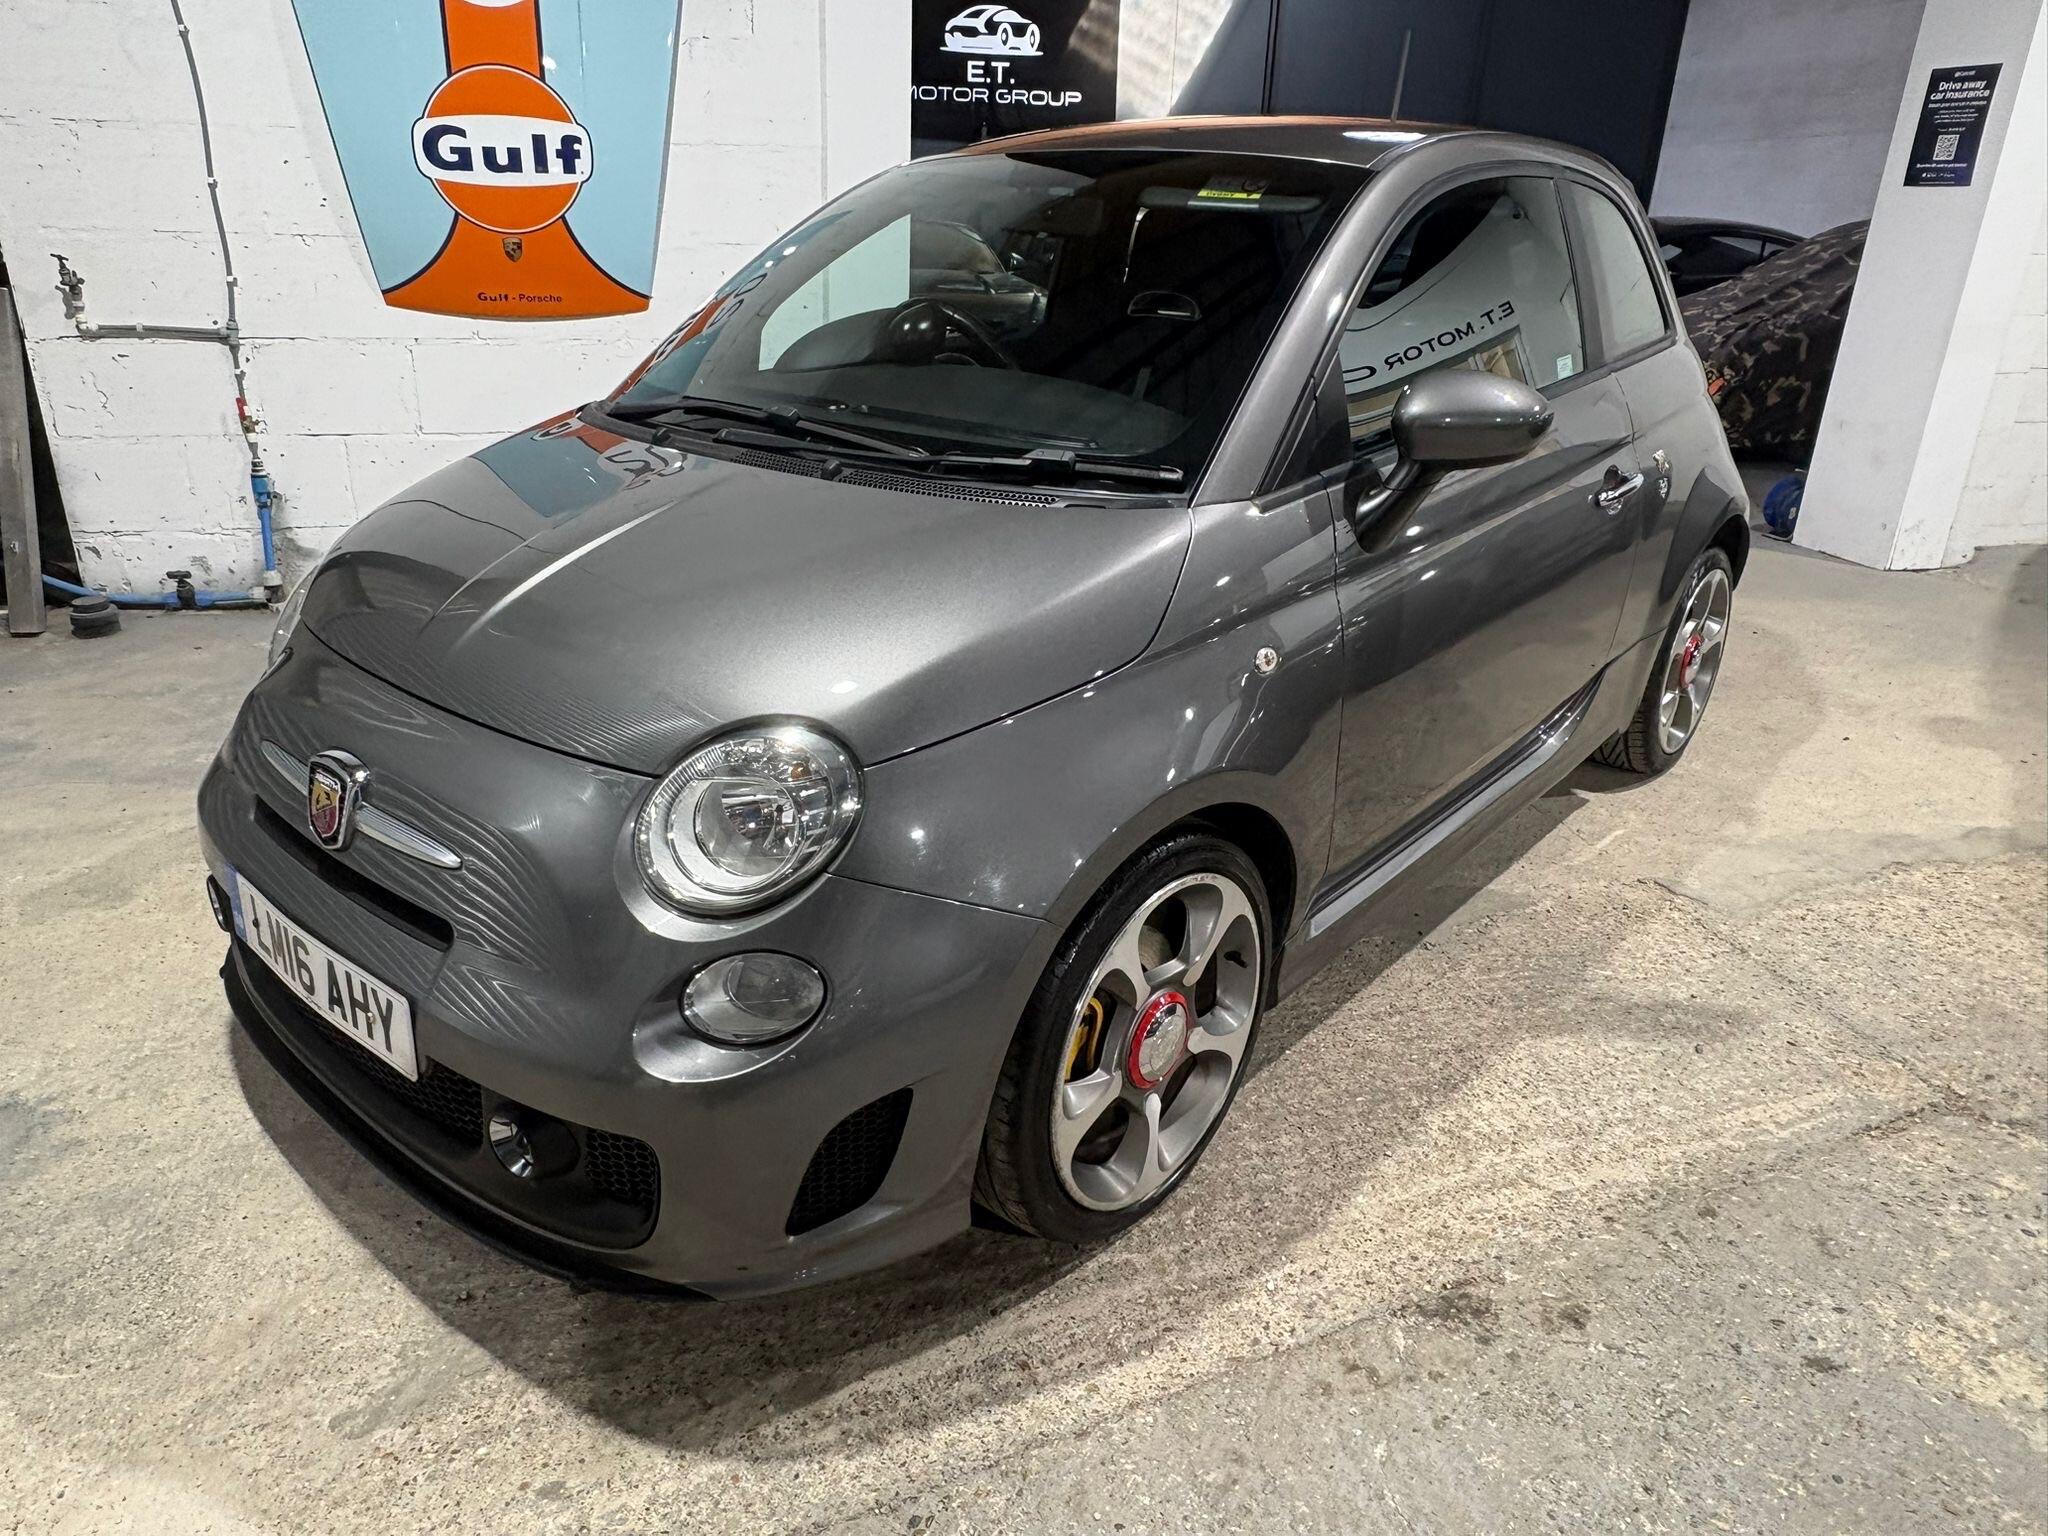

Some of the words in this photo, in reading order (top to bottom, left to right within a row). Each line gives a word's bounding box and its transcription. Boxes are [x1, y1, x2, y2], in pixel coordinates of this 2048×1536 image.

[967, 60, 1015, 84] E.T.
[1939, 81, 1962, 91] Drive
[1962, 80, 1987, 90] away
[995, 89, 1082, 107] GROUP
[1931, 92, 1946, 100] car
[1945, 90, 1990, 100] insurance
[422, 124, 583, 175] Gulf
[518, 293, 562, 303] Porsche
[250, 893, 316, 996] LM16
[326, 957, 394, 1055] AHY
